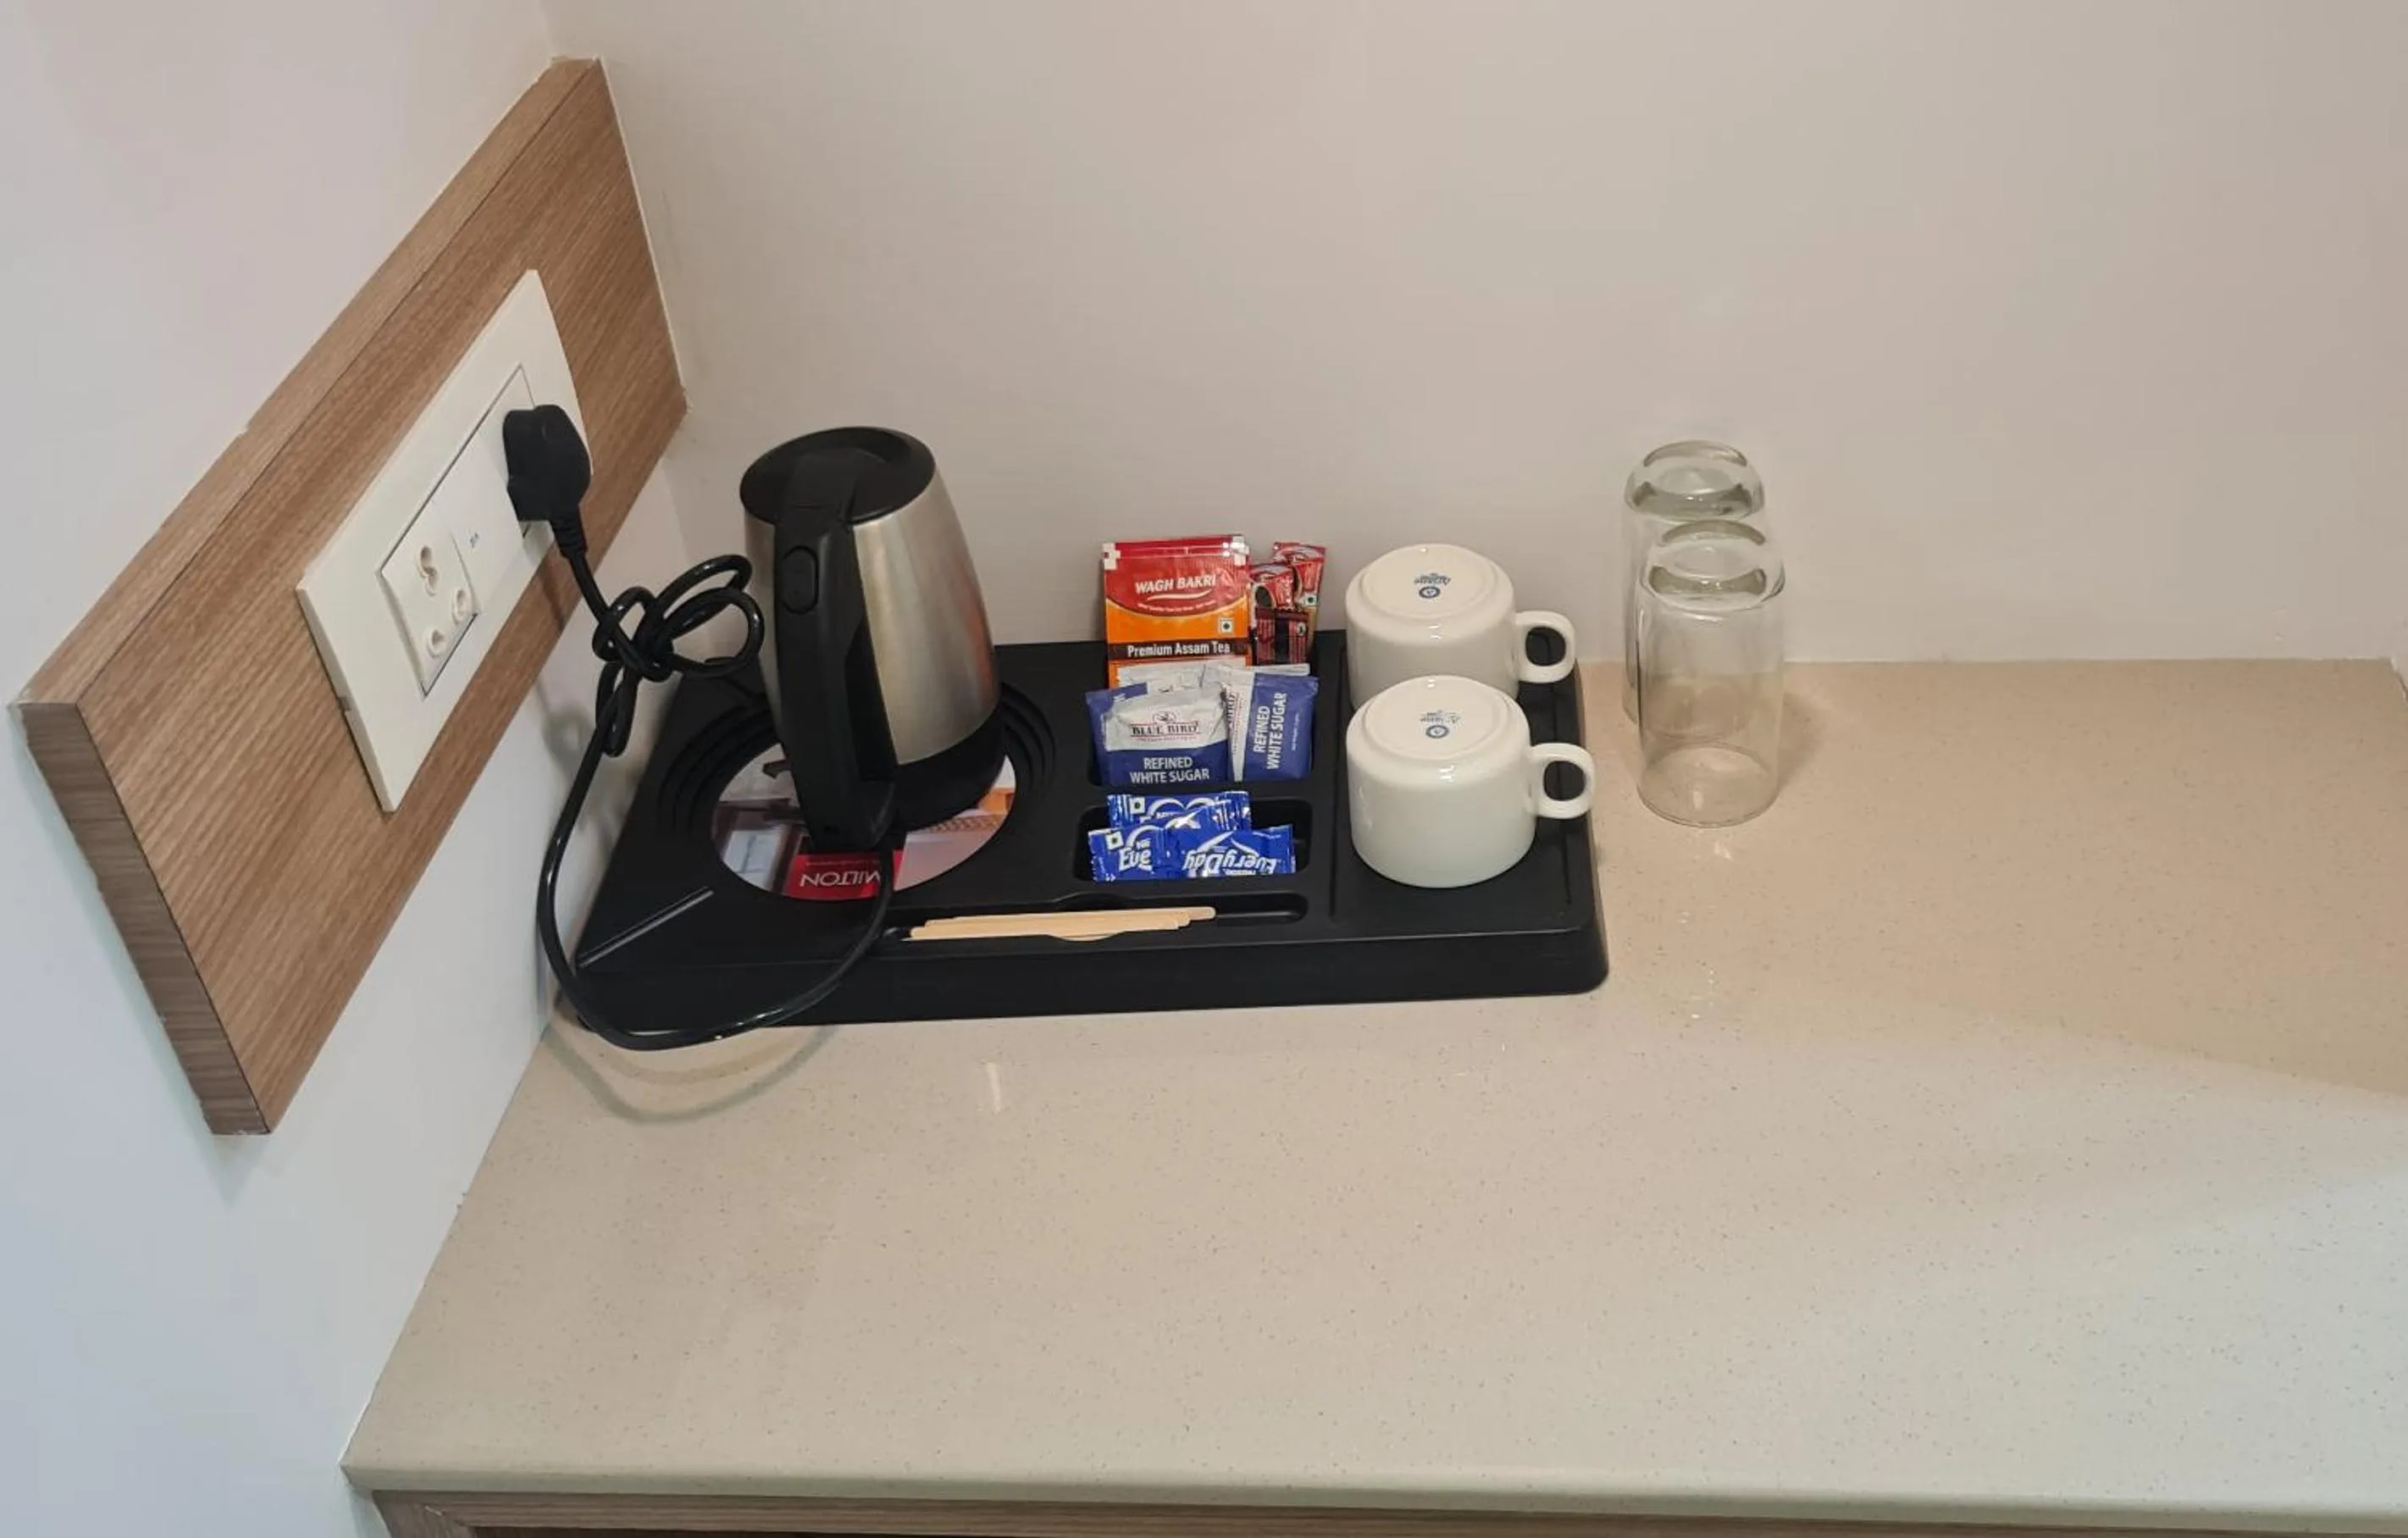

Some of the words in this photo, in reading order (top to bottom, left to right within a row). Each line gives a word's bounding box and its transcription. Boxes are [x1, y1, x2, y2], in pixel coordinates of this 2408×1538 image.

[1135, 579, 1174, 594] WAGH
[1176, 574, 1216, 589] BAKRI
[1127, 644, 1172, 657] Premium
[1174, 642, 1210, 655] Assam
[1211, 640, 1231, 654] Tea
[1270, 692, 1287, 731] SUGAR
[1254, 705, 1270, 753] REFINED
[1266, 733, 1283, 770] WHITE
[1143, 756, 1193, 770] REFINED
[1129, 772, 1168, 783] WHITE
[1169, 768, 1210, 783] SUGAR
